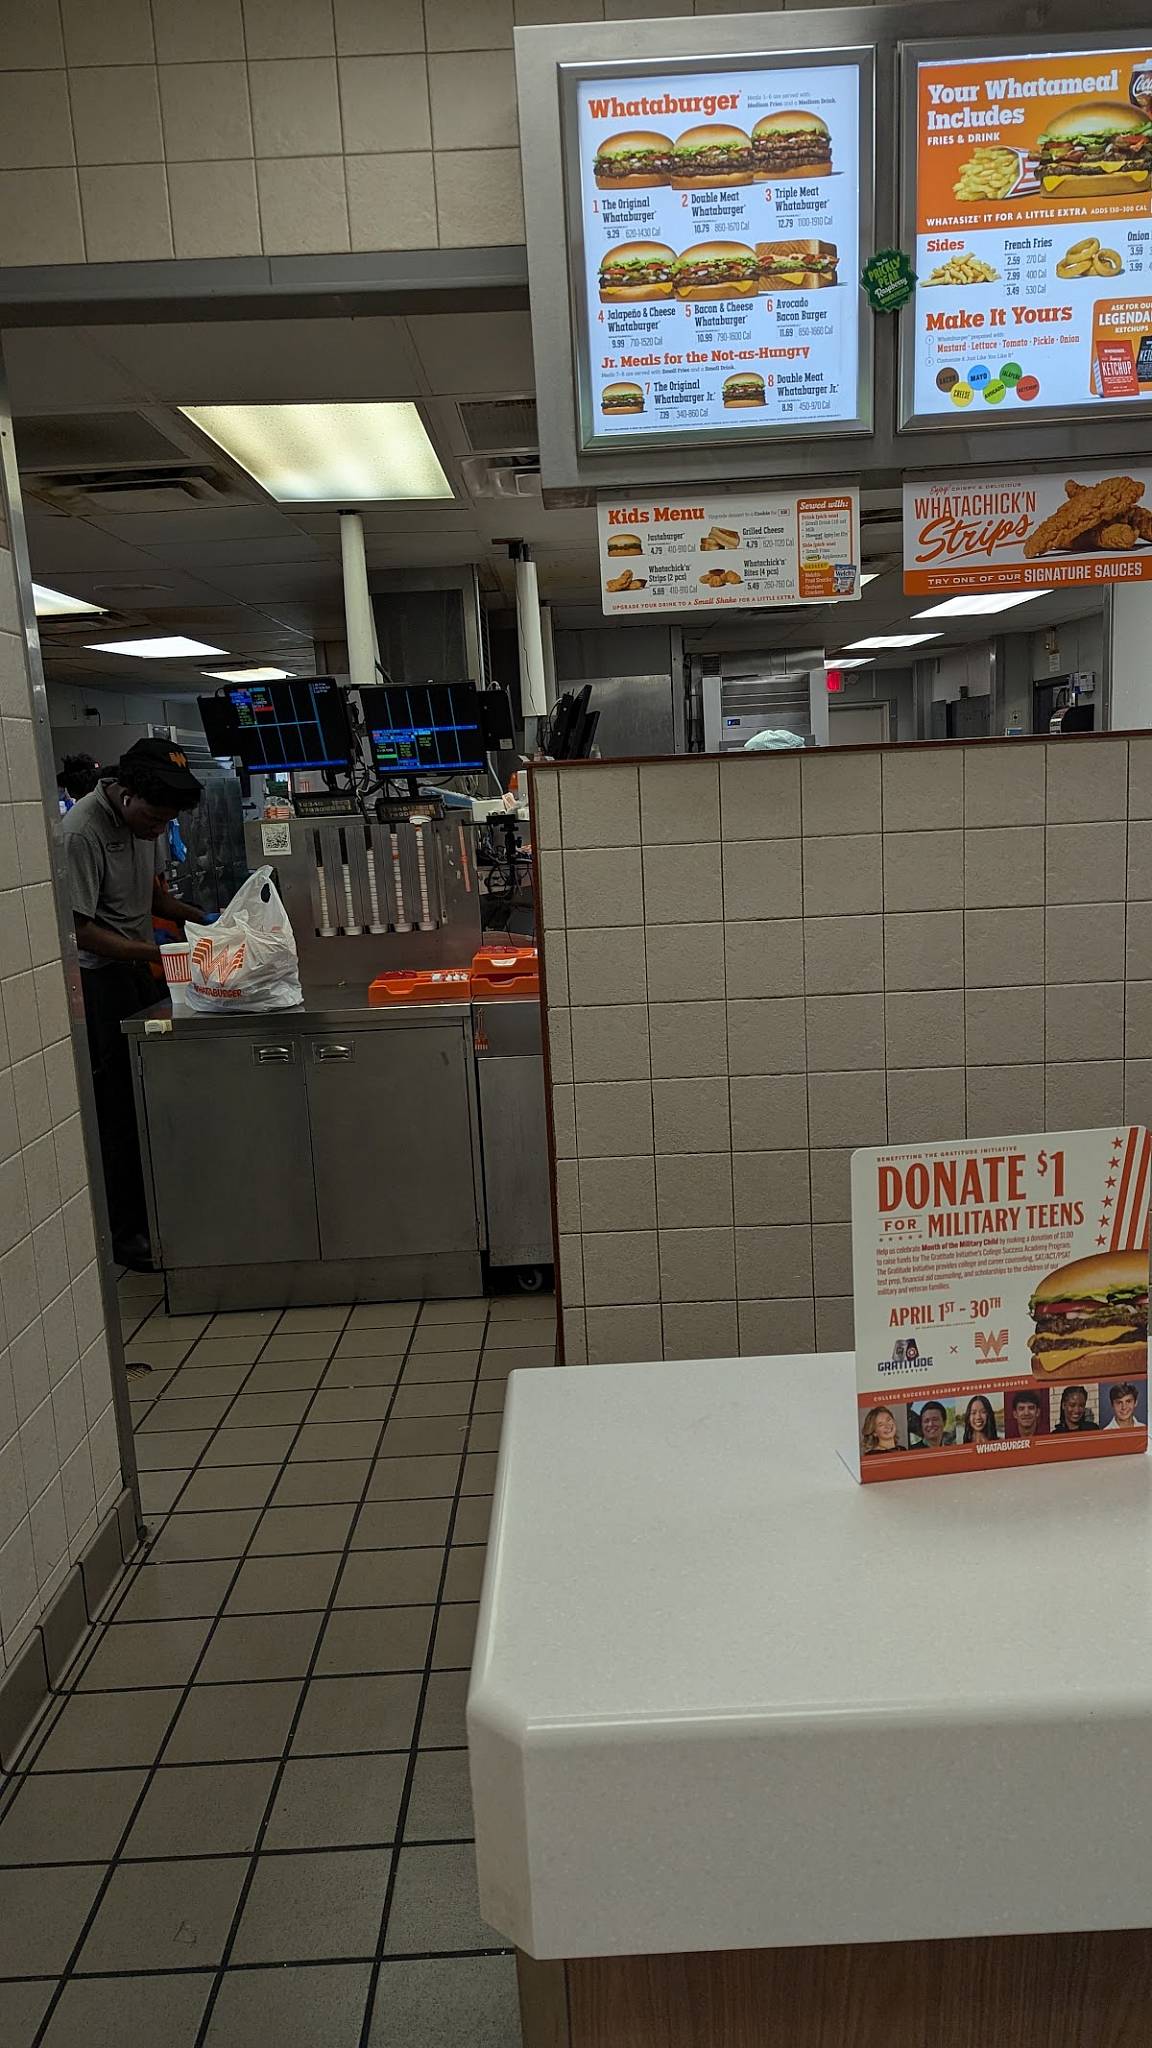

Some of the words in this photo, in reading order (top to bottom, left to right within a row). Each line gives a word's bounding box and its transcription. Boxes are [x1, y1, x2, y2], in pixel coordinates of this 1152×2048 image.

[928, 84, 979, 104] Your
[985, 70, 1119, 99] Whatameal
[588, 93, 740, 118] Whataburger
[927, 105, 1024, 130] Includes
[928, 136, 954, 145] FRIES
[958, 135, 964, 143] &
[968, 132, 1000, 142] DRINK
[682, 194, 688, 207] 2
[691, 192, 718, 204] Double
[720, 191, 739, 203] Meat
[765, 189, 771, 201] 3
[775, 187, 797, 199] Triple
[800, 187, 819, 198] Meat
[593, 200, 599, 213] 1
[602, 200, 616, 210] The
[618, 196, 650, 211] Original
[691, 204, 745, 217] Whataburger
[775, 199, 829, 212] Whataburger
[602, 211, 655, 223] Whataburger
[778, 219, 793, 228] 12.79
[927, 215, 979, 226] WHATASIZE
[984, 213, 992, 222] IT
[996, 212, 1013, 221] FOR
[1016, 211, 1023, 219] A
[1026, 209, 1055, 218] LITTLE
[1058, 207, 1087, 217] EXTRA
[1127, 231, 1150, 241] Onion
[927, 239, 965, 252] Sides
[1004, 238, 1031, 250] French
[1033, 237, 1052, 248] Fries
[1026, 254, 1037, 264] 270
[1129, 262, 1142, 272] 3.99
[1007, 271, 1020, 281] 2.99
[1026, 270, 1037, 279] 400
[1006, 286, 1020, 296] 3.49
[1026, 285, 1037, 294] 530
[685, 305, 691, 317] 5
[695, 304, 718, 314] Bacon
[720, 303, 725, 312] &
[727, 301, 753, 312] Cheese
[767, 299, 773, 312] 6
[776, 297, 808, 308] Avocado
[598, 310, 604, 323] 4
[643, 308, 648, 317] &
[650, 306, 676, 317] Cheese
[695, 315, 748, 327] Whataburger
[776, 312, 799, 321] Bacon
[801, 310, 828, 321] Burger
[926, 310, 985, 331] Make
[990, 308, 1006, 326] It
[1012, 306, 1072, 324] Yours
[1099, 311, 1152, 326] LEGENDA
[608, 321, 660, 332] Whataburger
[1115, 325, 1149, 333] KETCHUPS
[612, 340, 625, 348] 9.99
[697, 334, 713, 342] 10.99
[937, 341, 966, 352] Mustard
[971, 340, 997, 350] Lettuce
[1003, 338, 1028, 348] Tomato
[1033, 336, 1055, 346] Pickle
[1060, 335, 1080, 344] Onion
[601, 358, 618, 368] Jr.
[621, 354, 661, 367] Meals
[664, 353, 683, 364] for
[686, 351, 708, 362] the
[711, 346, 810, 361] Not-as-Hungry
[1102, 361, 1132, 376] KETCHUP
[768, 374, 774, 387] 8
[777, 373, 803, 384] Double
[804, 372, 823, 382] Meat
[970, 373, 988, 382] MAYO
[645, 382, 651, 395] 7
[654, 382, 668, 392] The
[669, 379, 700, 392] Original
[778, 385, 827, 397] Whataburger
[829, 383, 839, 393] Jr.
[654, 393, 704, 405] Whataburger
[706, 392, 715, 401] Jr.
[953, 390, 970, 400] CHEESE
[914, 491, 1036, 520] WHATACHICK'N
[608, 508, 649, 524] Kids
[653, 507, 705, 522] Menu
[743, 527, 762, 536] Grilled
[763, 526, 784, 535] Cheese
[915, 514, 1035, 563] Strips
[649, 574, 666, 583] Strips
[928, 577, 950, 586] TRY
[953, 575, 976, 585] ONE
[979, 575, 994, 583] OF
[998, 573, 1021, 582] OUR
[1024, 565, 1092, 583] SIGNATURE
[1095, 562, 1142, 578] SAUCES
[693, 598, 714, 606] Small
[716, 597, 737, 605] Shake
[877, 1153, 922, 1162] BENEFITTING
[940, 1149, 977, 1157] GRATITUDE
[980, 1146, 1017, 1154] INITIATIVE
[878, 1154, 1027, 1213] DONATE
[1037, 1150, 1065, 1198] $1
[884, 1219, 917, 1232] FOR
[928, 1207, 1021, 1238] MILITARY
[1027, 1201, 1084, 1230] TEENS
[922, 1243, 941, 1251] Month
[960, 1240, 982, 1248] Military
[889, 1304, 934, 1327] APRIL
[938, 1301, 955, 1321] 1ST
[970, 1296, 1002, 1318] 30TH
[878, 1357, 934, 1372] GRATITUDE
[873, 1394, 901, 1402] COLLEGE
[902, 1390, 930, 1399] SUCCESS
[932, 1387, 960, 1395] ACADEMY
[962, 1383, 991, 1391] PROGRAM
[993, 1379, 1028, 1388] GRADUATES
[976, 1439, 1030, 1454] WHATABURGER
